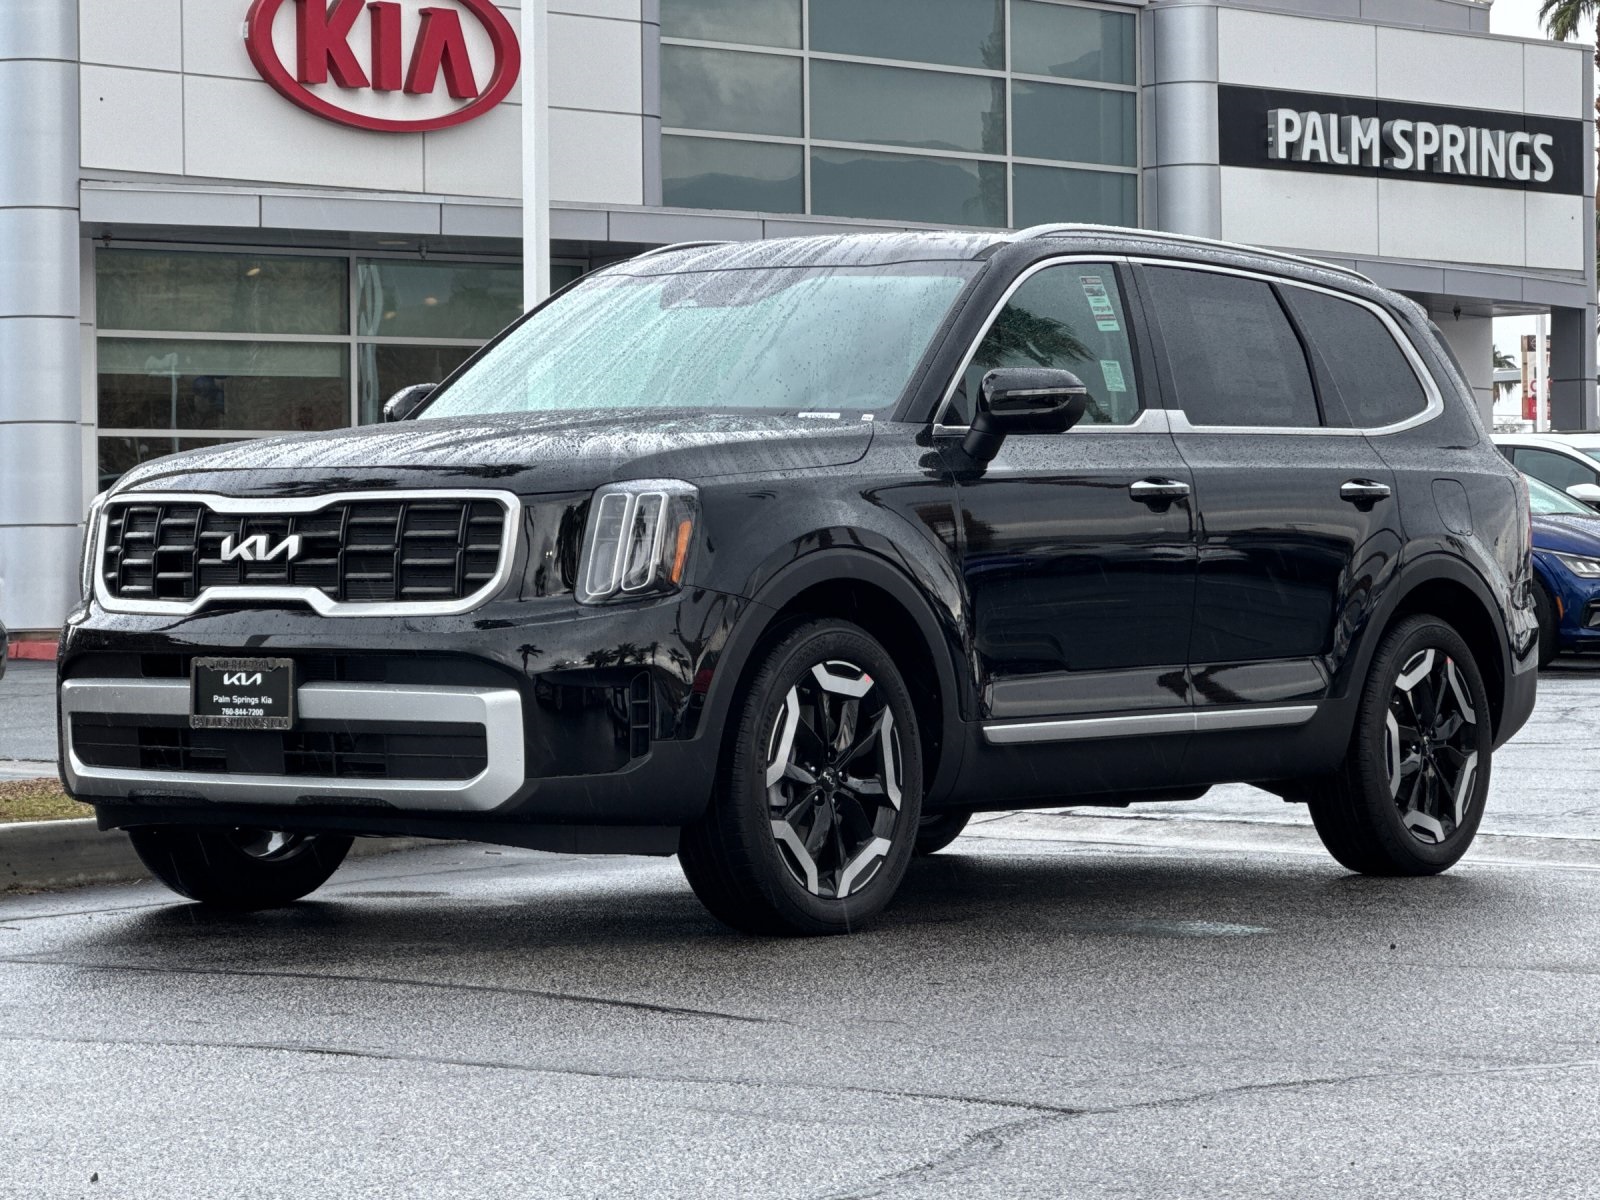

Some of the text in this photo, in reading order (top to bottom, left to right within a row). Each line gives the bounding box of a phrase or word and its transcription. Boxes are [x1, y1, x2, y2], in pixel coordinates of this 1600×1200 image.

[296, 0, 479, 98] KIA
[1267, 108, 1554, 182] PALM SPRINGS
[221, 534, 301, 561] KIA
[223, 672, 262, 685] KIA
[213, 695, 273, 705] Palm Springs Kia
[221, 707, 264, 716] 760-844-7200
